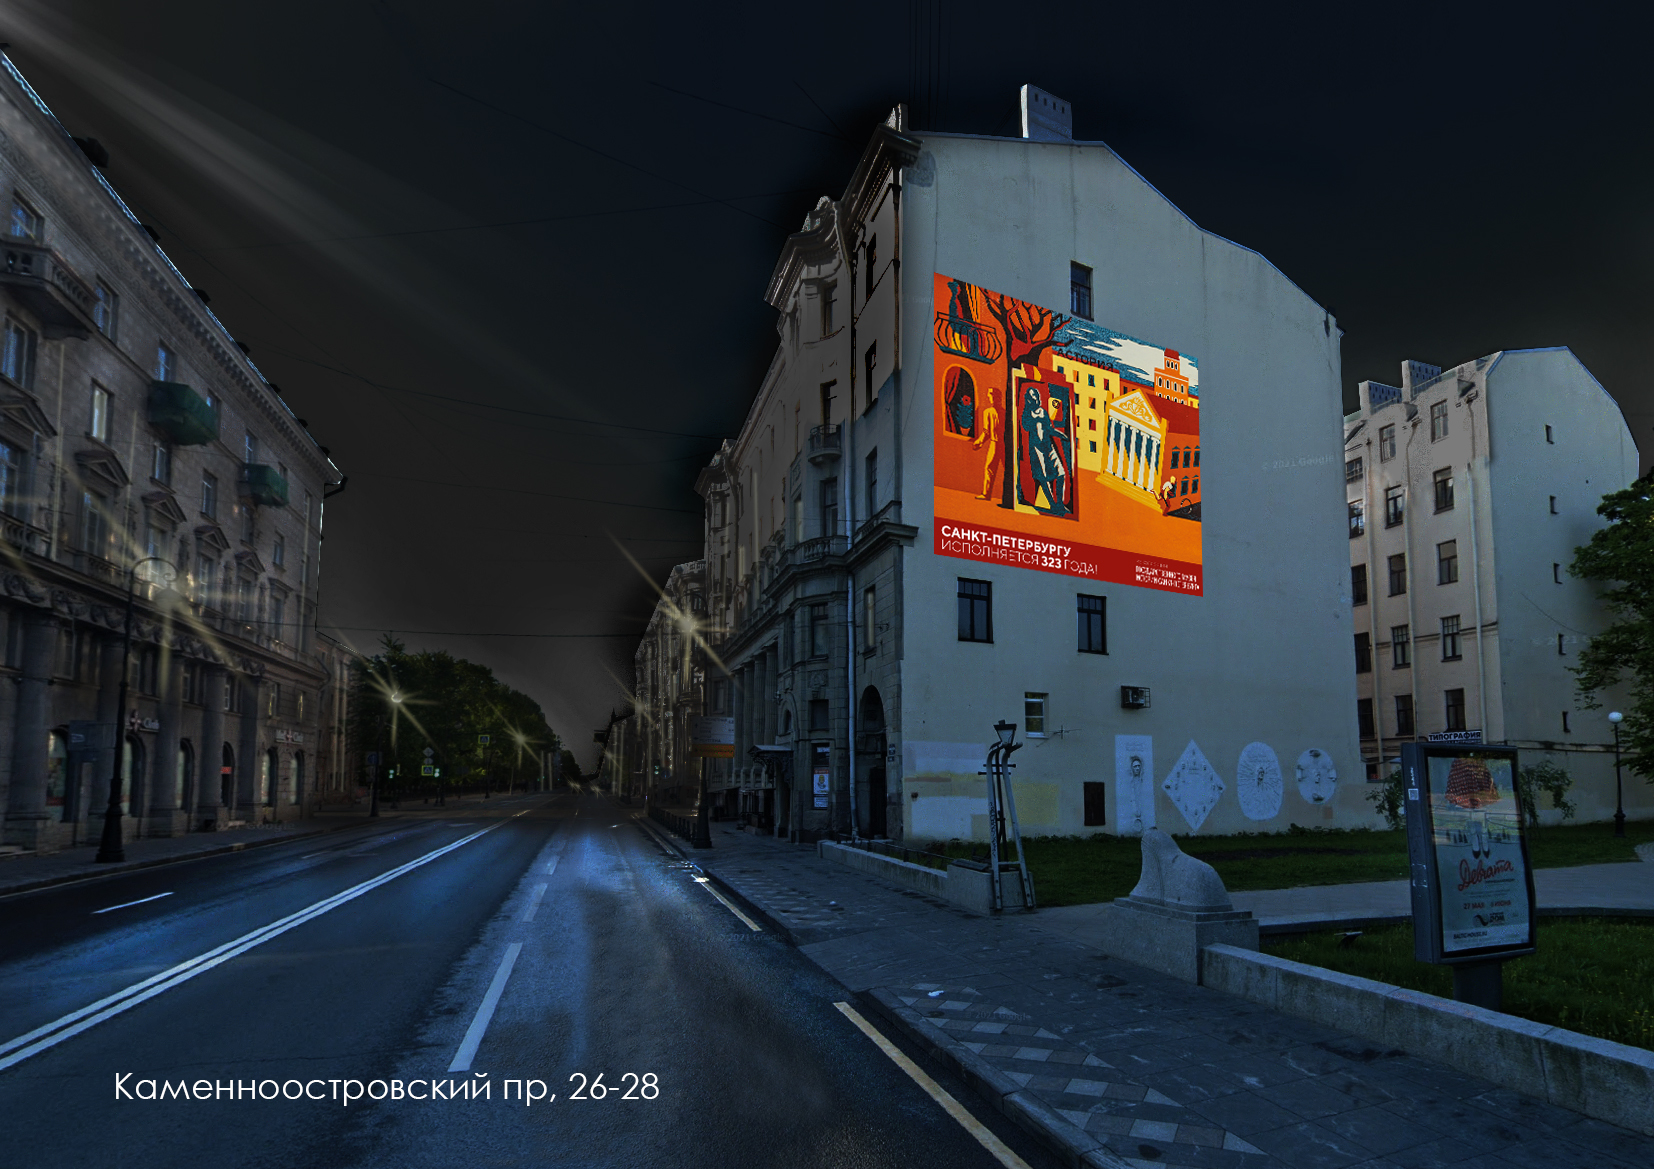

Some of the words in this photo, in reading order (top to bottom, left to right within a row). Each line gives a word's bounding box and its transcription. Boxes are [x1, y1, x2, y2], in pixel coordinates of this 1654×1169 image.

[1056, 347, 1115, 371] АСТОРИЯ
[940, 524, 1072, 557] САНКТ-ПЕТЕРБУРГУ
[940, 538, 1040, 566] ИСПОЛНЯЕТСЯ
[1041, 555, 1062, 570] 323
[1063, 559, 1099, 577] ГОДА!
[1428, 732, 1481, 741] ТИПОГРАФИЯ
